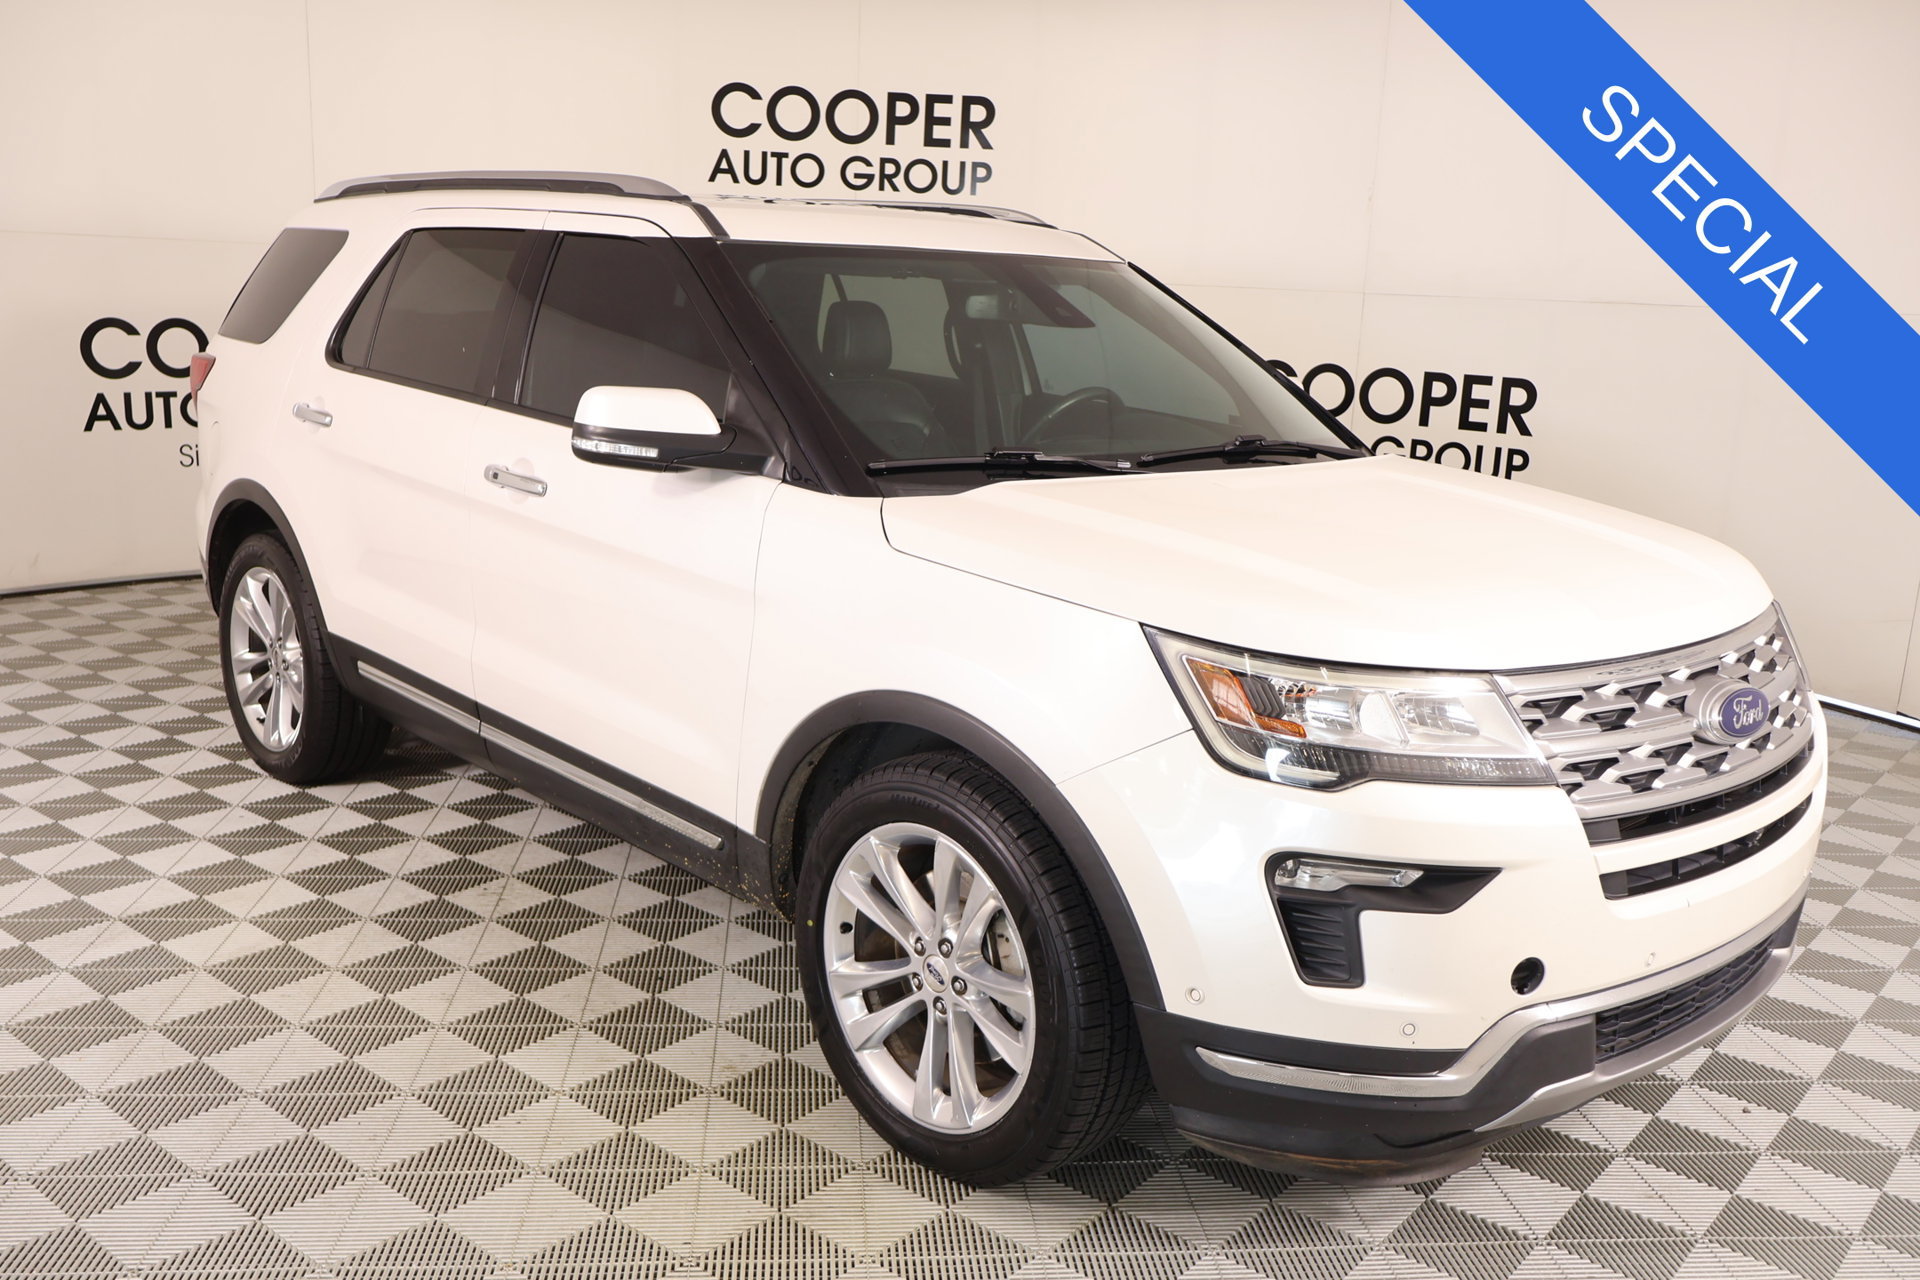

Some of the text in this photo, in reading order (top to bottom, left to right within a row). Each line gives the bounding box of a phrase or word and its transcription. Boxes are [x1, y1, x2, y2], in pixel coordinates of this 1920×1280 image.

[711, 82, 996, 150] COOPER
[708, 149, 992, 195] AUTO GROUP
[1733, 695, 1763, 729] Ford
